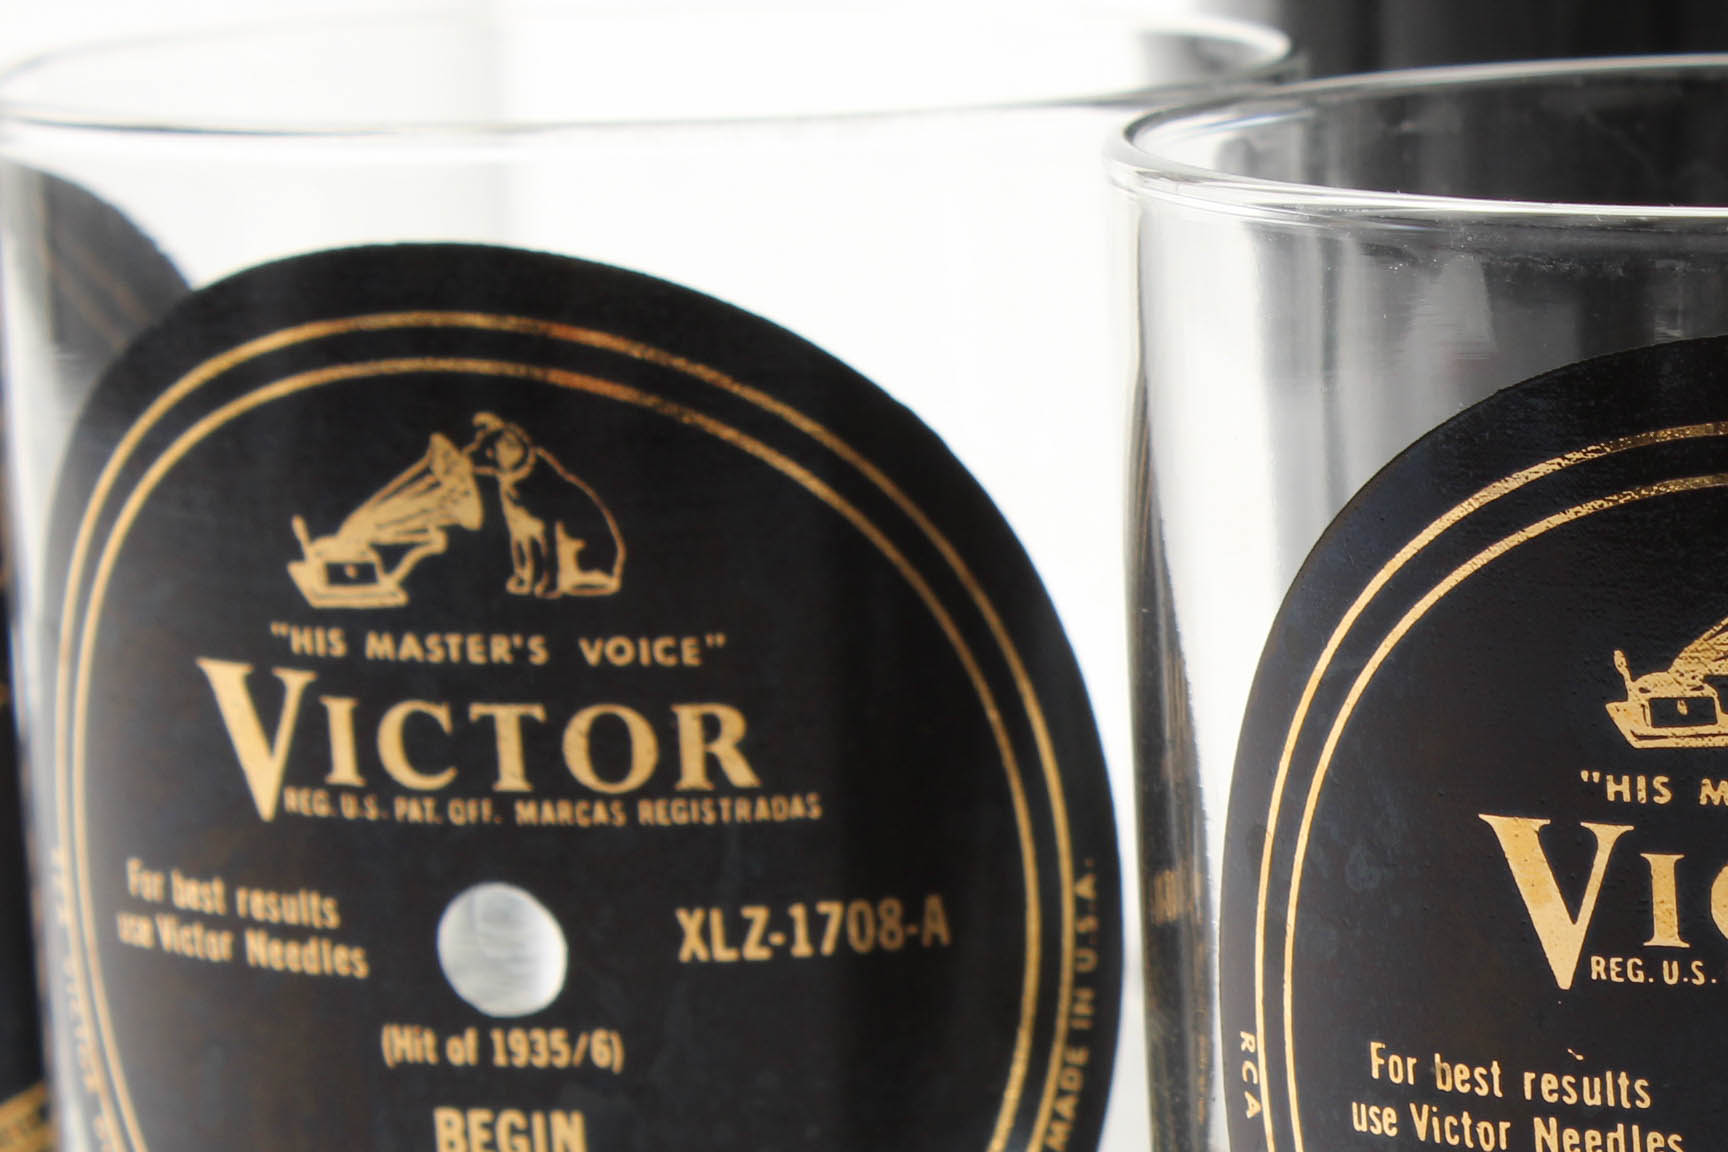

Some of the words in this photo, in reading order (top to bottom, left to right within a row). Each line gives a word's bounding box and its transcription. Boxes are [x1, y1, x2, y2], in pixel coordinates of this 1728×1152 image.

[270, 621, 347, 657] "HIS
[365, 630, 549, 665] MASTER'S
[579, 632, 727, 667] VOICE"
[196, 657, 762, 822] VICTOR
[514, 799, 627, 827] MARCAS
[637, 793, 823, 826] REGISTRADAS
[1579, 769, 1673, 804] "HIS
[126, 857, 165, 903] For
[171, 868, 227, 916] best
[235, 886, 341, 929] results
[156, 912, 234, 963] Victor
[245, 927, 370, 979] Needles
[675, 893, 952, 963] XLZ-1708-A
[1590, 955, 1655, 984] REG.
[1662, 959, 1717, 986] U.S.
[1070, 987, 1096, 1031] IN
[381, 1024, 439, 1069] (Hit
[446, 1027, 478, 1066] of
[491, 1027, 624, 1074] 1935/6)
[1239, 1030, 1263, 1120] RCA
[1369, 1041, 1418, 1086] For
[1433, 1052, 1504, 1099] best
[1523, 1069, 1651, 1110] results
[1351, 1100, 1399, 1138] use
[1409, 1102, 1512, 1152] Victor
